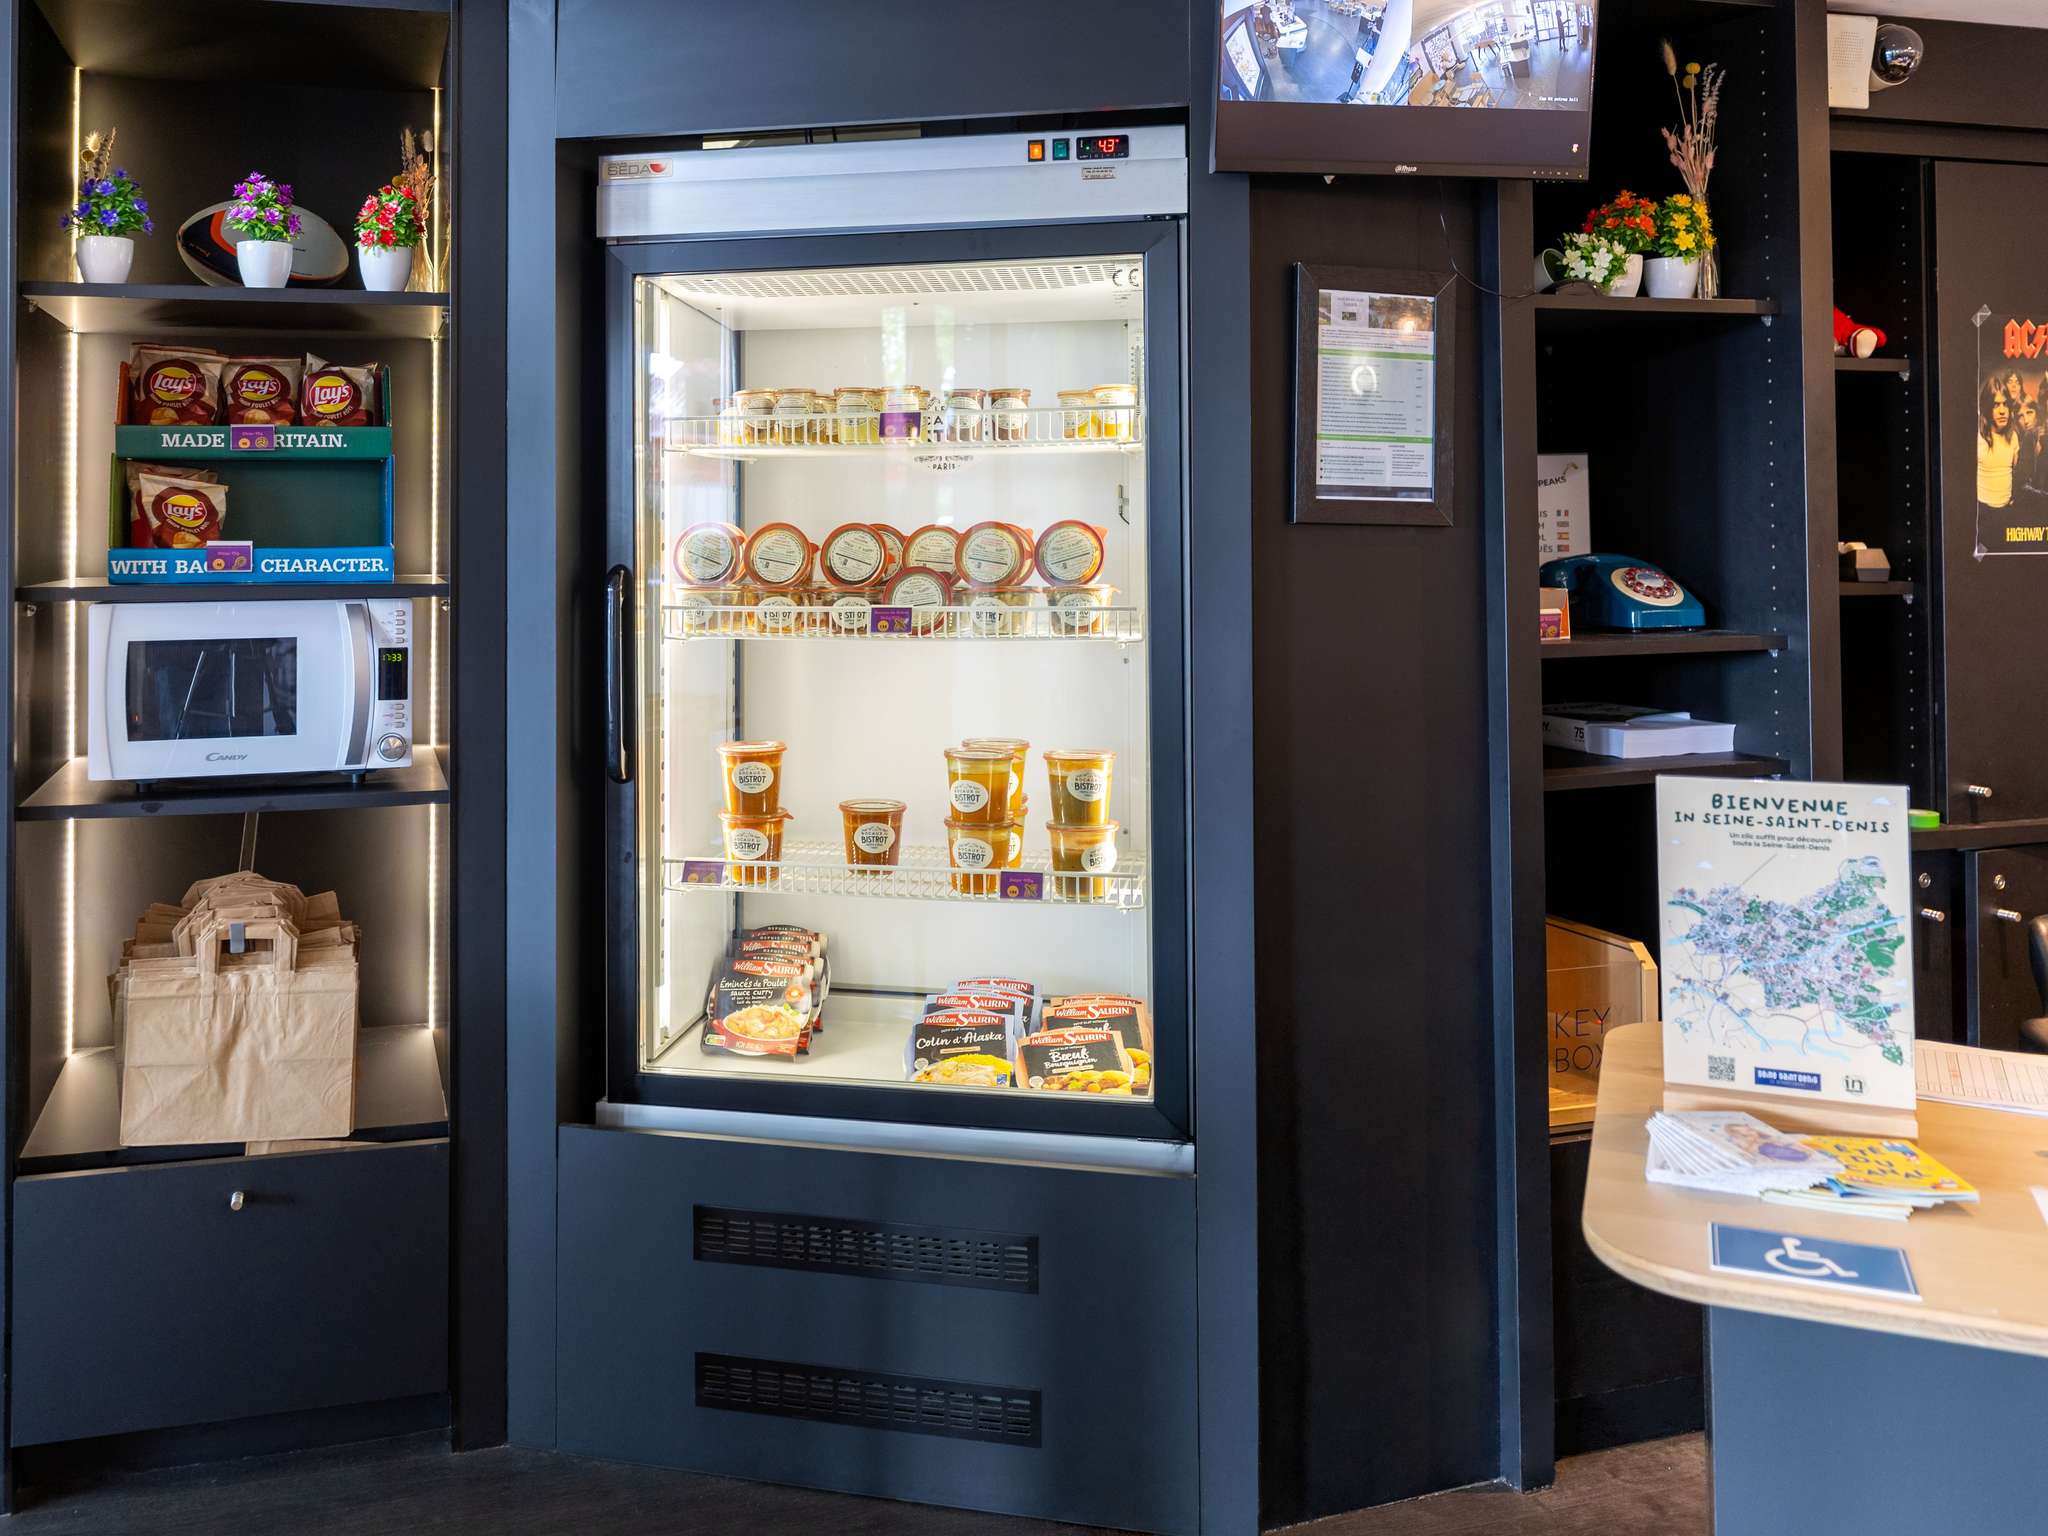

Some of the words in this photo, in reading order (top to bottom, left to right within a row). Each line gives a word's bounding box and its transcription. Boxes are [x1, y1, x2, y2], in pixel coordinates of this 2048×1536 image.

[314, 384, 350, 405] Lay's
[161, 433, 225, 448] MADE
[275, 433, 347, 448] RITAIN.
[1538, 476, 1567, 487] PEAKS
[2006, 527, 2043, 542] HIGHWAY
[110, 560, 168, 575] WITH
[261, 558, 389, 573] CHARACTER.
[1574, 726, 1585, 739] 75
[206, 752, 249, 762] CANDY
[738, 775, 767, 784] BISTROT
[954, 793, 981, 802] BISTROT
[1711, 793, 1848, 815] BIENVENUE
[1674, 811, 1695, 823] IN
[1703, 812, 1890, 833] SEINE-SAINT-DENIS
[734, 841, 761, 851] BISTROT
[861, 835, 889, 844] BISTROT
[958, 851, 986, 862] BISTROT
[734, 960, 763, 972] William
[762, 961, 801, 976] SAURIN
[720, 976, 752, 988] Émincés
[762, 979, 788, 987] Poulet
[730, 989, 750, 997] sauce
[753, 990, 773, 998] curry
[937, 997, 968, 1006] William
[967, 995, 1009, 1009] SAURIN
[1056, 1008, 1087, 1017] William
[1087, 1004, 1130, 1019] SAURIN
[925, 1016, 957, 1024] William
[956, 1013, 998, 1026] SAURIN
[1555, 1007, 1611, 1039] KEY
[916, 1036, 952, 1049] Colin
[1031, 1037, 1064, 1045] William
[1064, 1031, 1107, 1045] SAURIN
